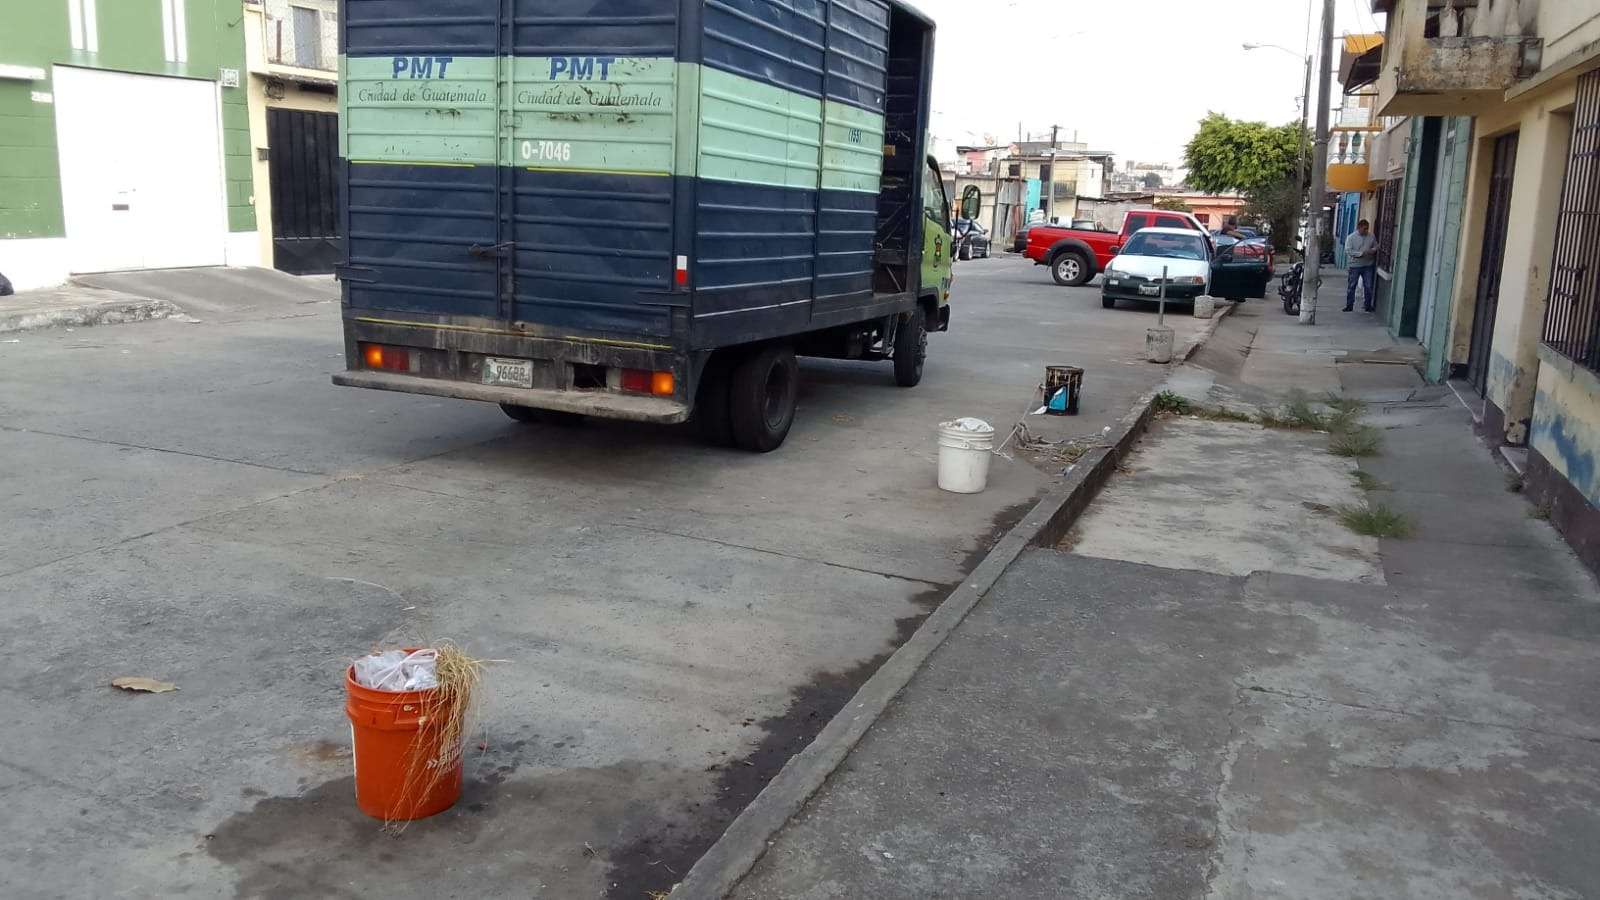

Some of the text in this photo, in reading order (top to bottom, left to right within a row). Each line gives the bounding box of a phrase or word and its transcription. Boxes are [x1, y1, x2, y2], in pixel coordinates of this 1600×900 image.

[392, 57, 453, 79] PMT
[549, 57, 616, 81] PMT
[358, 87, 487, 102] Ciudad de Guatemala
[518, 90, 662, 107] Ciudad de Guatemala
